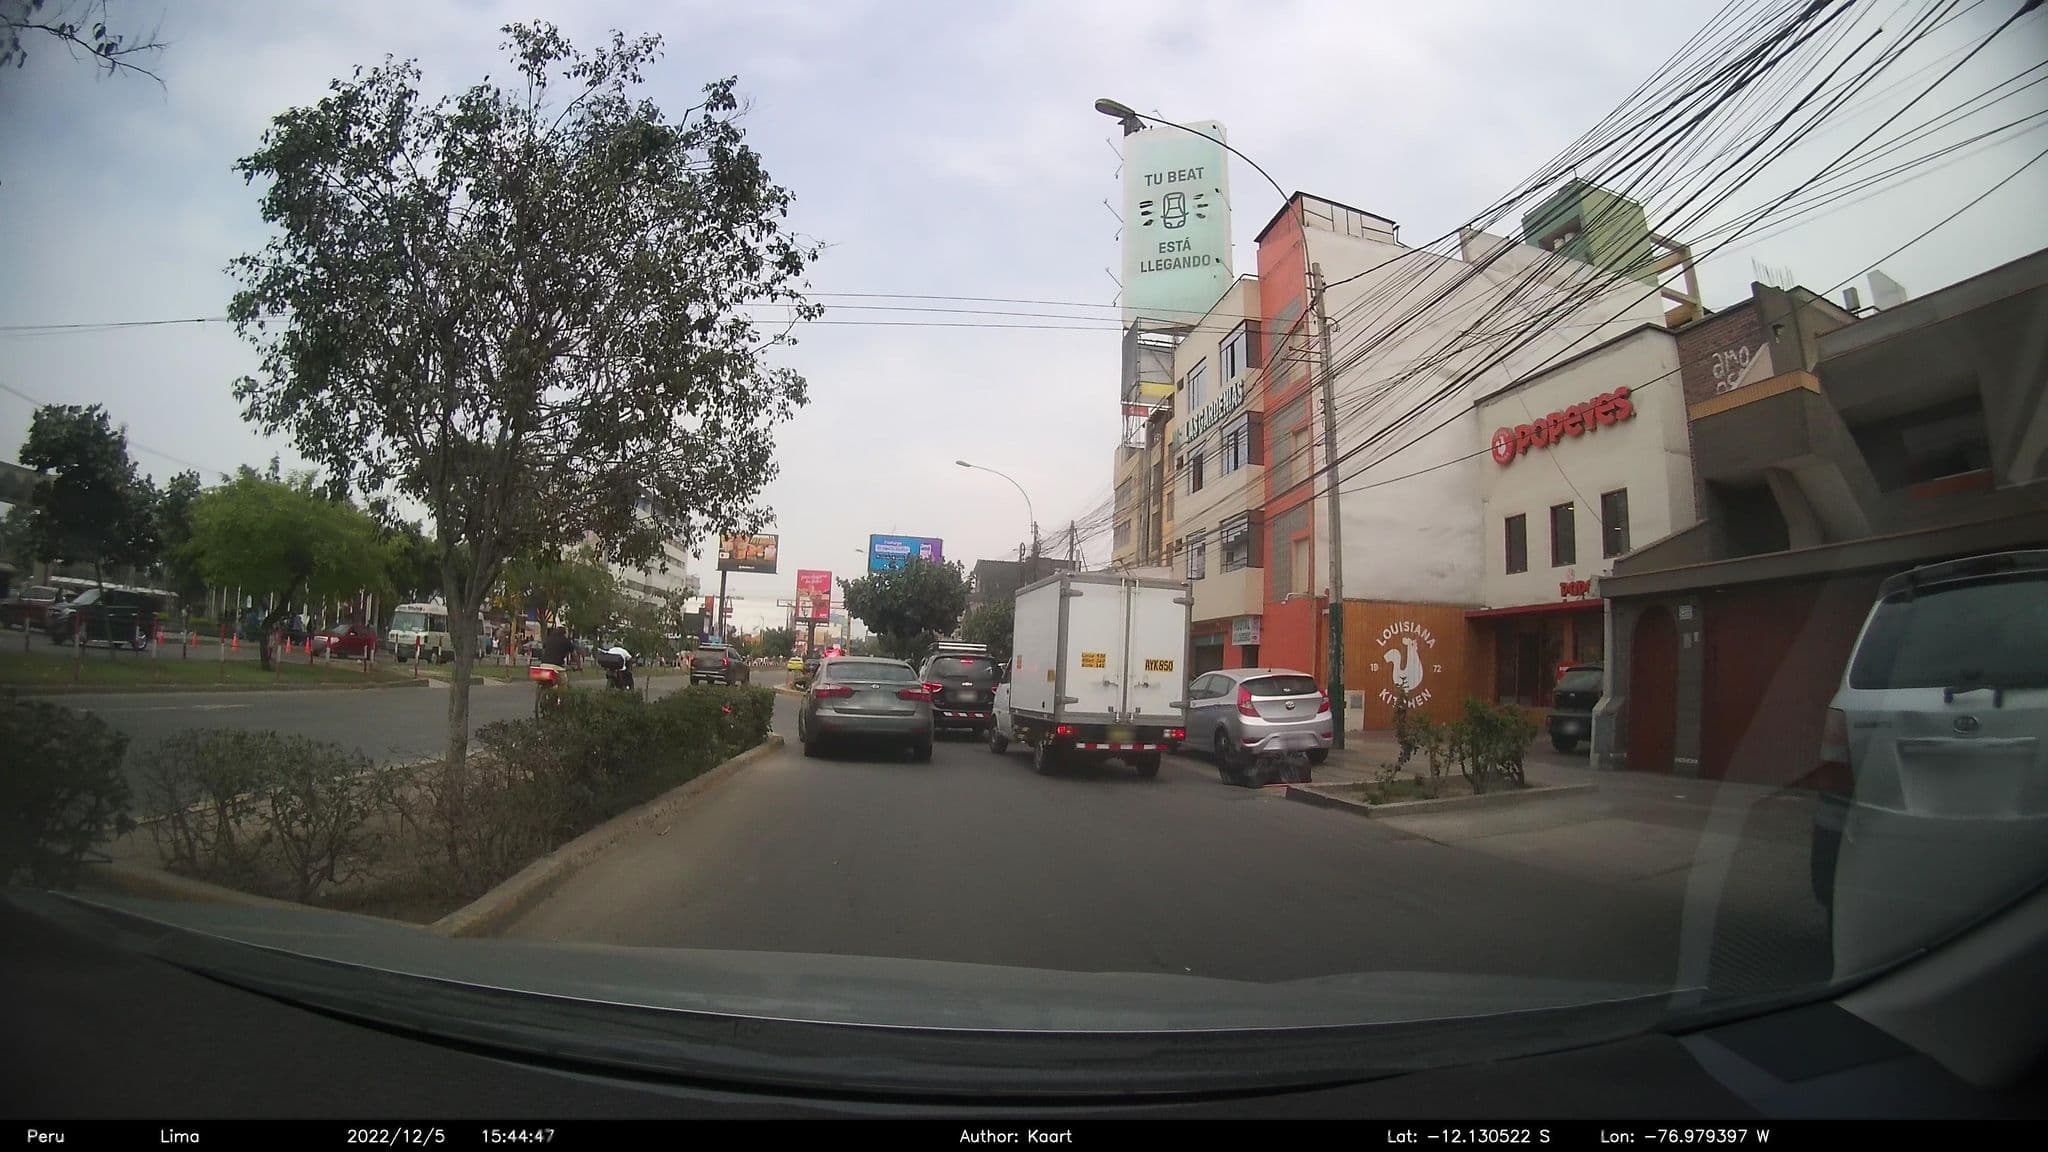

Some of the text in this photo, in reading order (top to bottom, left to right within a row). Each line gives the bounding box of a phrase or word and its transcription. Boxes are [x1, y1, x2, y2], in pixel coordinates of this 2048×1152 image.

[1144, 167, 1205, 187] TU BEAT
[1158, 237, 1192, 254] ESTÁ
[1140, 254, 1211, 273] LLEGANDO
[1199, 379, 1245, 434] GARDENIAS
[1376, 621, 1436, 649] LOUISIANA
[1432, 664, 1442, 673] 72
[1379, 688, 1432, 709] KITHEN
